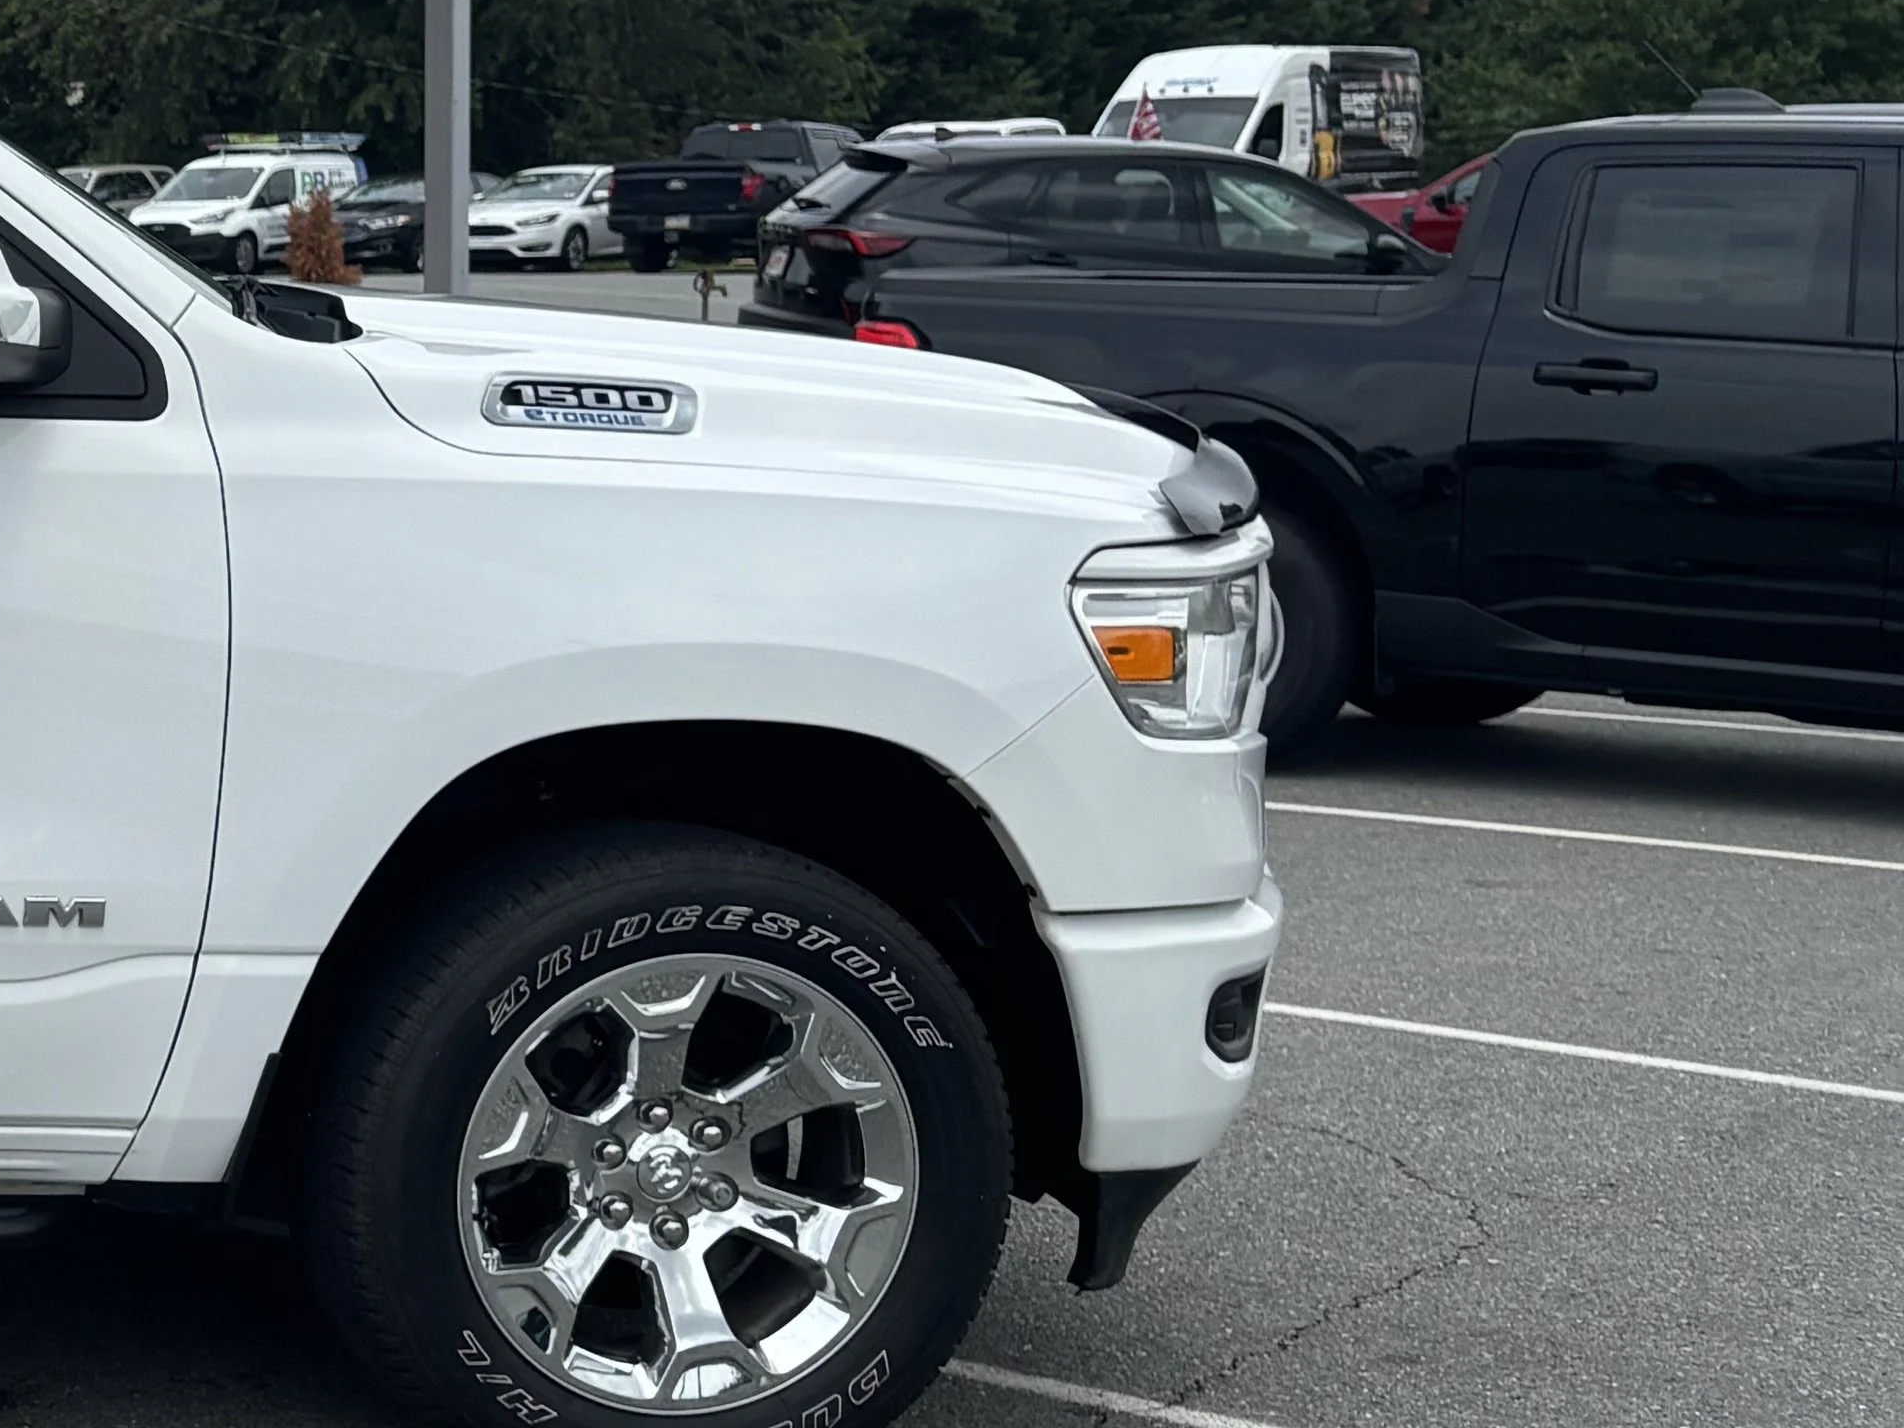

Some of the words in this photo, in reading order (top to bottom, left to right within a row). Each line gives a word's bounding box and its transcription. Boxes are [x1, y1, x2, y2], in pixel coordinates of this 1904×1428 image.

[512, 384, 667, 411] 1500
[485, 905, 954, 1049] BRIDGESTONE
[456, 1329, 558, 1425] H/L
